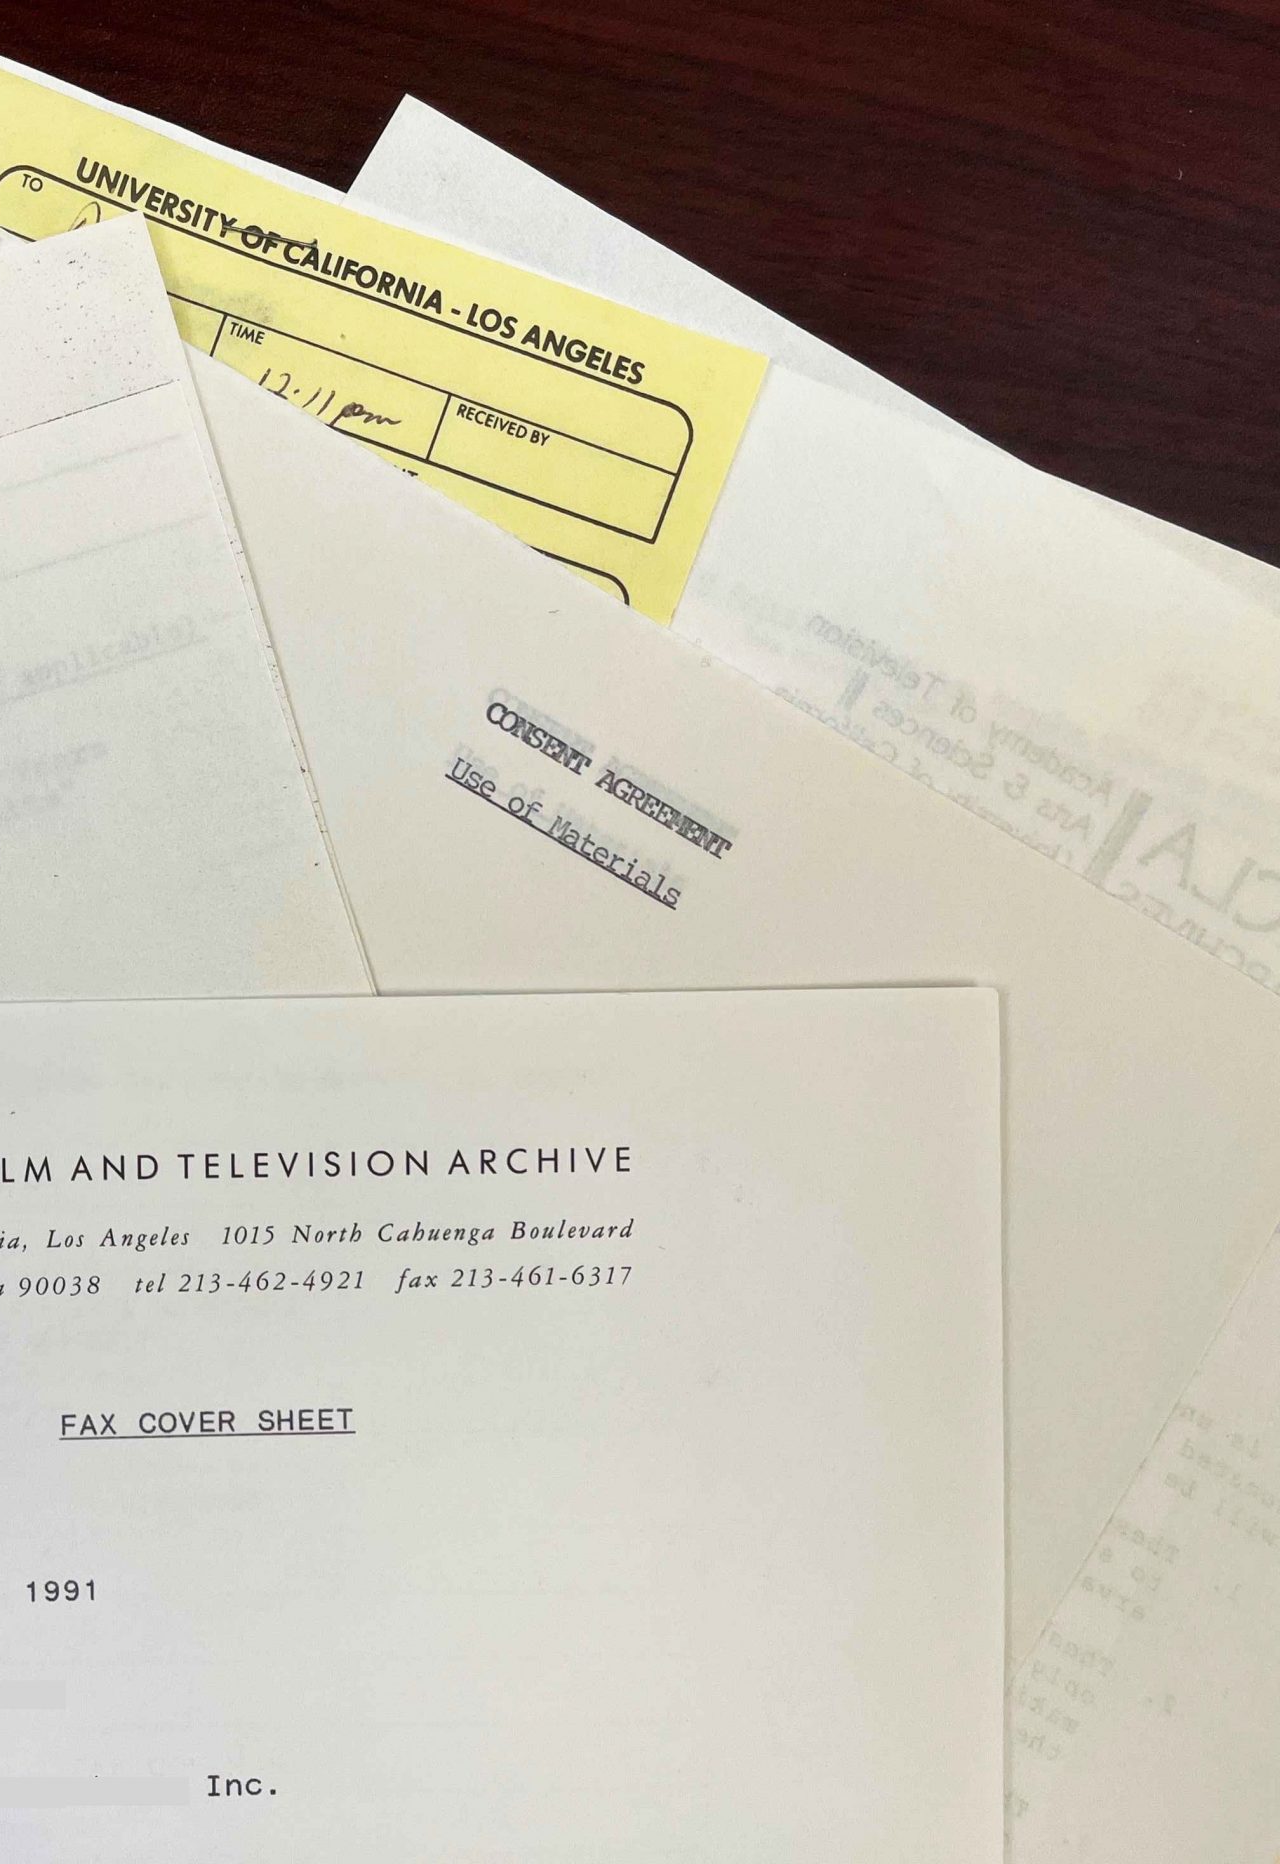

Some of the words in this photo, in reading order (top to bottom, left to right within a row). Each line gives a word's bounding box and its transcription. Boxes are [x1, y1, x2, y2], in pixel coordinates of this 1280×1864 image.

[20, 172, 44, 193] TO
[75, 155, 239, 240] UNIVERSITY
[239, 223, 283, 262] OF
[284, 239, 442, 315] CALIFORNIA
[465, 301, 519, 340] LOS
[519, 323, 646, 385] ANGELES
[228, 320, 266, 345] TIME
[455, 402, 528, 439] RECEIVED
[528, 426, 556, 447] BY
[485, 701, 593, 776] CONSENT
[593, 767, 733, 860] AGREEMENT
[450, 757, 497, 800] Use
[505, 794, 542, 822] of
[546, 816, 682, 907] Materials
[69, 1153, 159, 1182] AND
[175, 1148, 429, 1180] TELEVISION
[447, 1145, 631, 1175] ARCHIVE
[45, 1228, 85, 1249] Los
[98, 1225, 190, 1253] Angeles
[221, 1224, 274, 1245] 1015
[290, 1221, 362, 1244] North
[376, 1220, 495, 1247] Cahuenga
[509, 1217, 635, 1240] Boulevard
[18, 1274, 101, 1298] 90038
[133, 1271, 167, 1294] tel
[176, 1268, 363, 1294] 213-462-4921
[393, 1266, 438, 1295] fax
[449, 1264, 632, 1289] 213-461-6317
[60, 1412, 117, 1436] FAX
[137, 1409, 236, 1434] COVER
[257, 1406, 354, 1432] SHEET
[25, 1578, 95, 1603] 1991
[206, 1773, 277, 1797] Inc.
